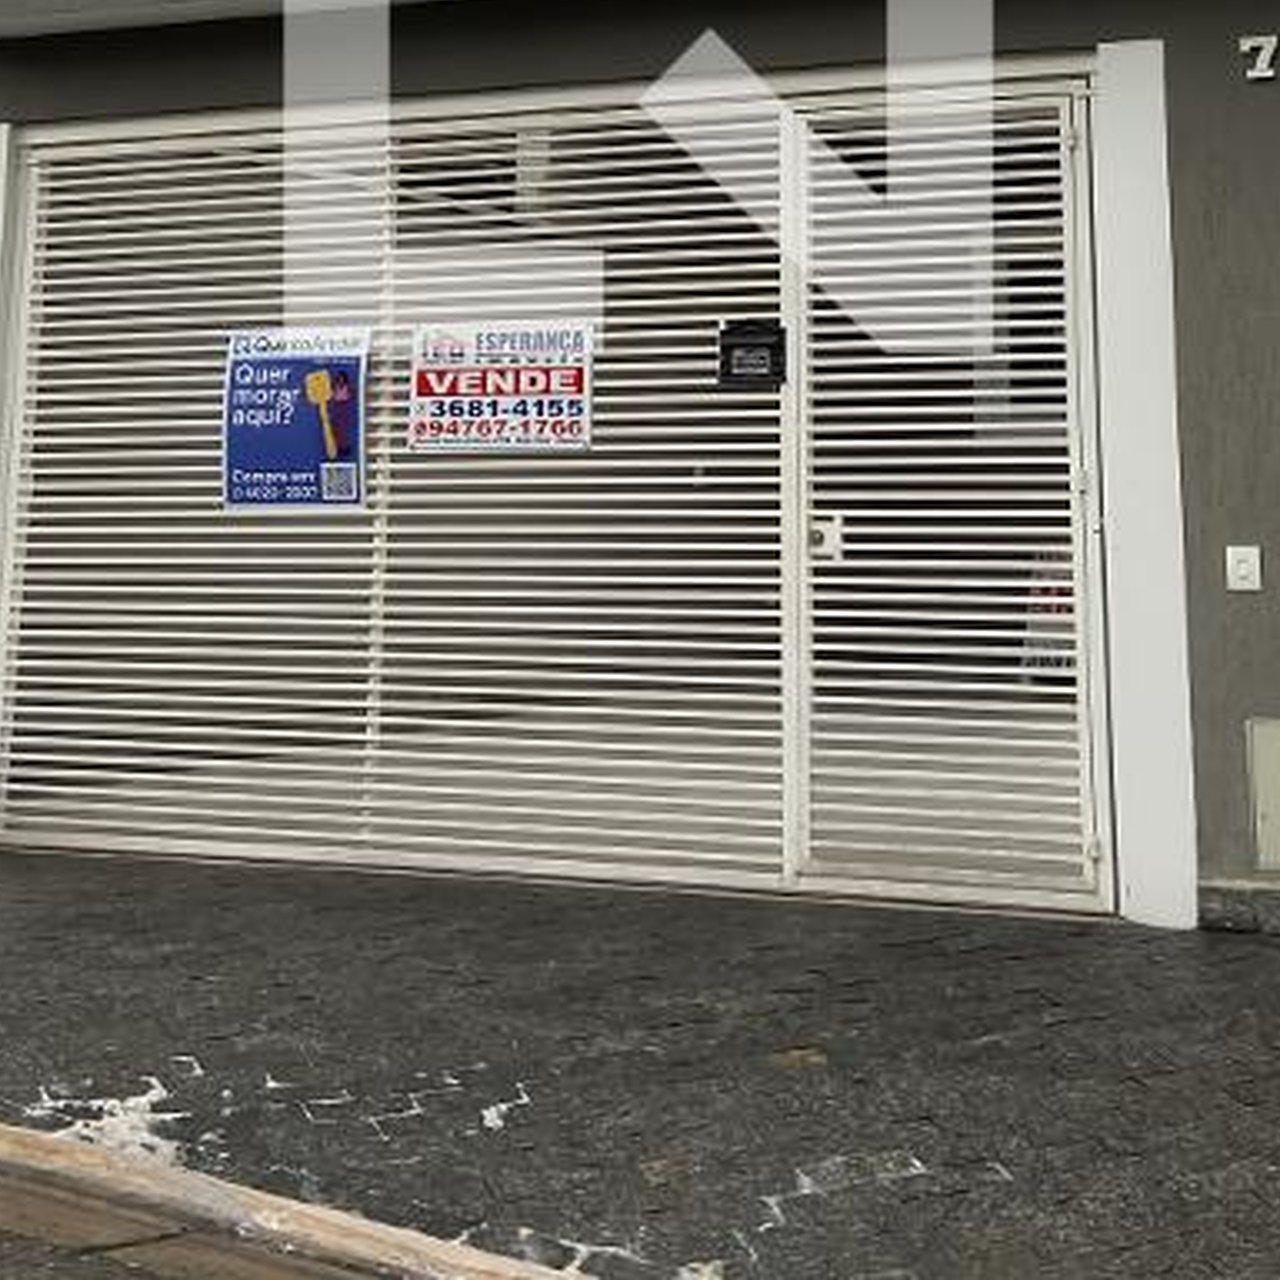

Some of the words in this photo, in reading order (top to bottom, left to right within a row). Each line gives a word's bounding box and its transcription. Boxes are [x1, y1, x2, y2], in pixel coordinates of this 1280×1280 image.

[234, 363, 291, 384] Quer
[425, 370, 578, 394] VENDE
[232, 389, 301, 405] morar
[232, 402, 295, 428] aqui?
[430, 399, 584, 417] 3681-4155
[429, 419, 583, 437] 94767-1766
